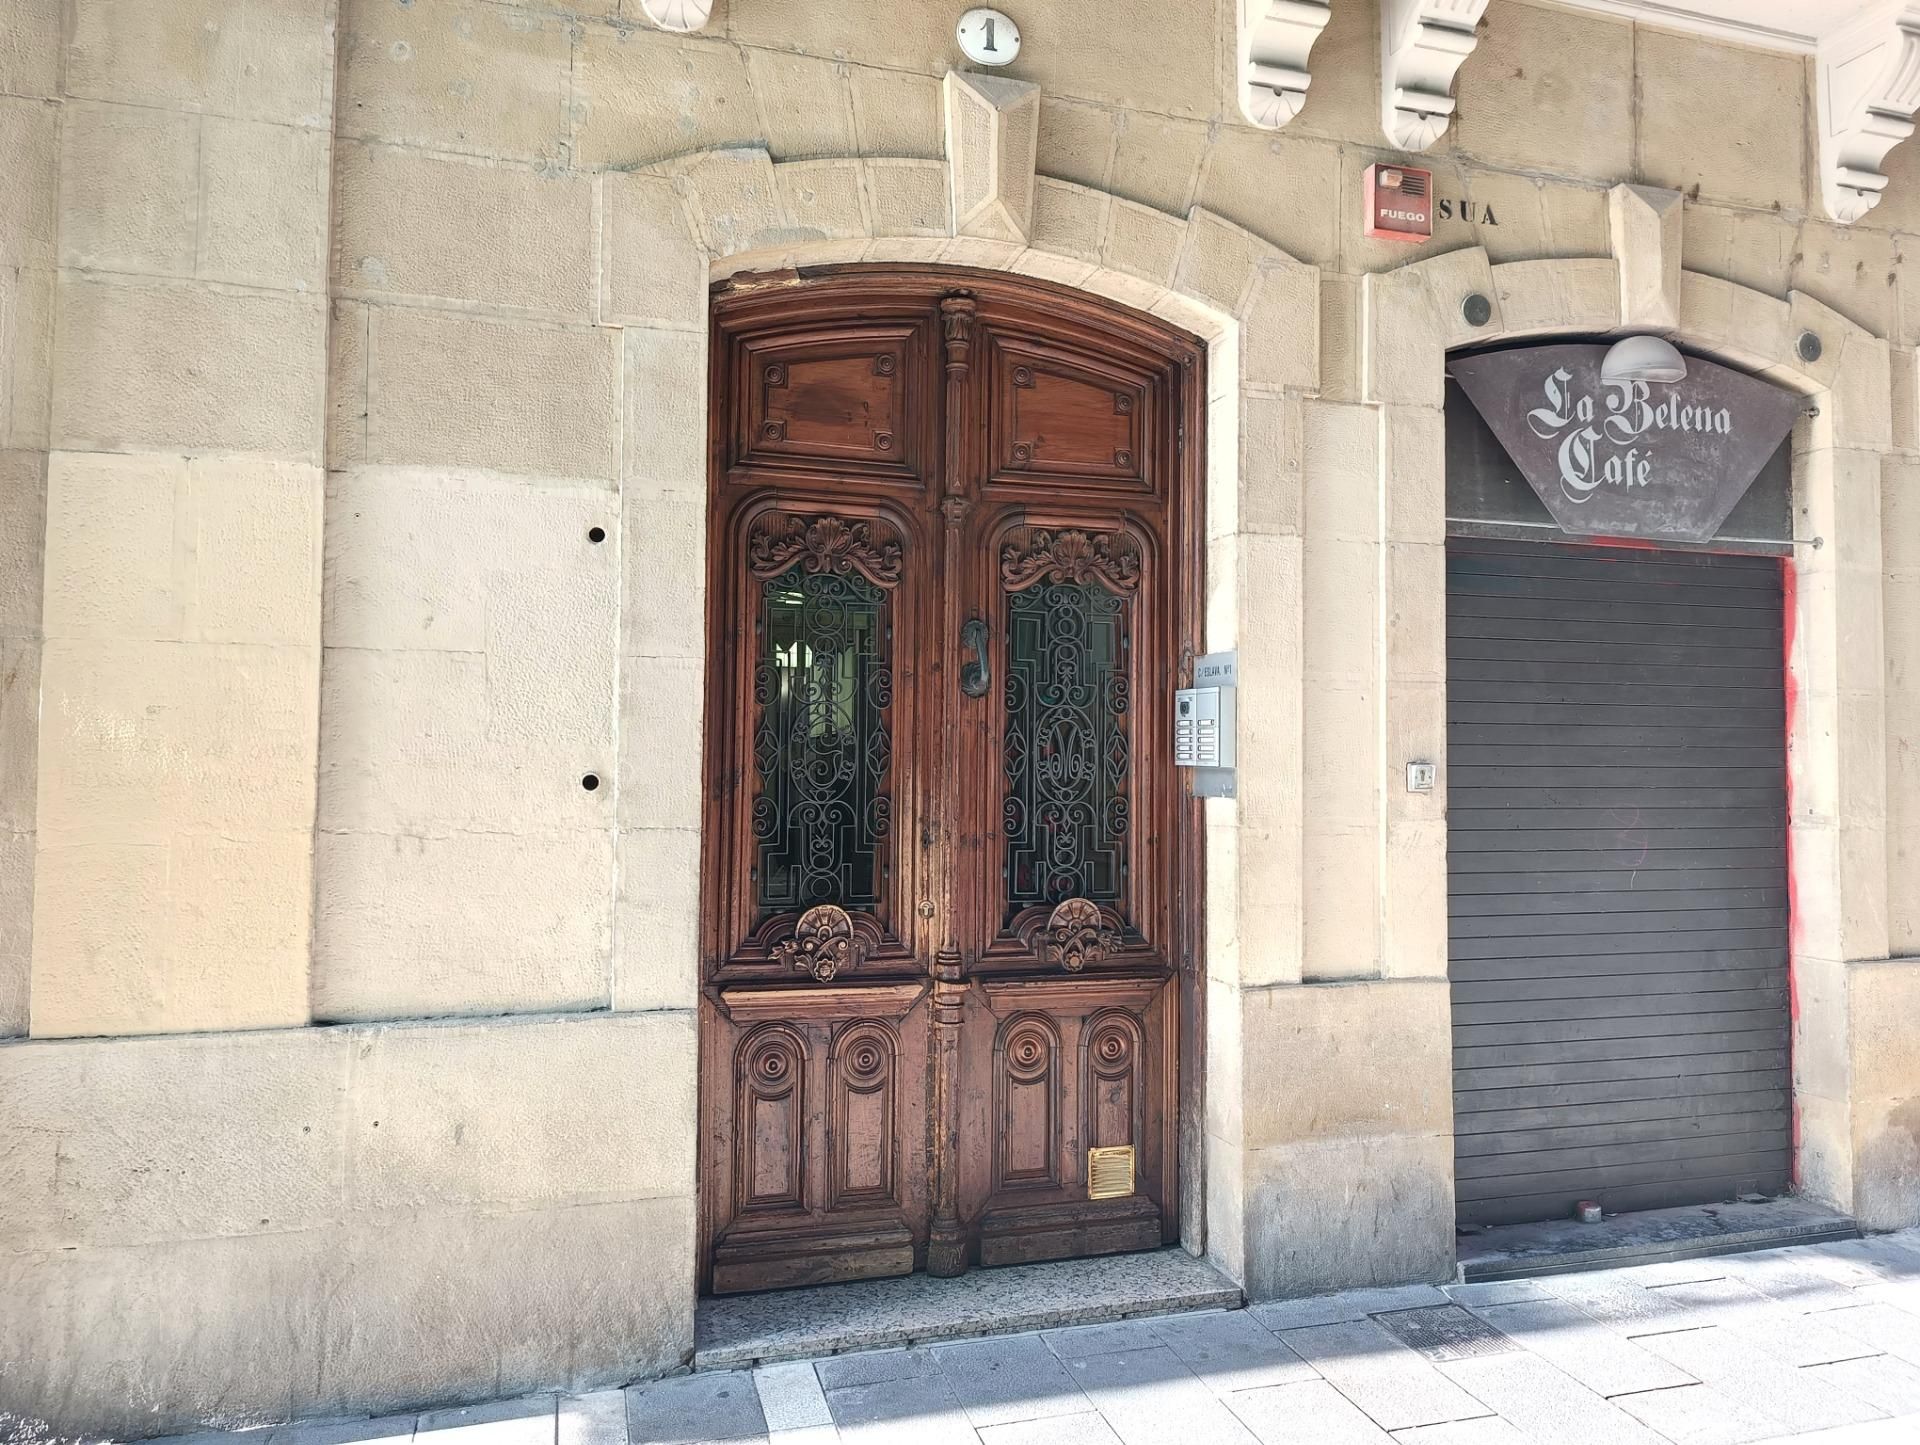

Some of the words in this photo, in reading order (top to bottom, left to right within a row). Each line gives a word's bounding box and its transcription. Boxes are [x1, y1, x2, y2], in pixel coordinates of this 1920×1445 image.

[980, 18, 998, 52] 1
[1379, 208, 1426, 223] FUEGO
[1439, 198, 1499, 226] SUA
[1526, 366, 1595, 440] La
[1602, 379, 1733, 446] Belena
[1557, 426, 1653, 504] Café
